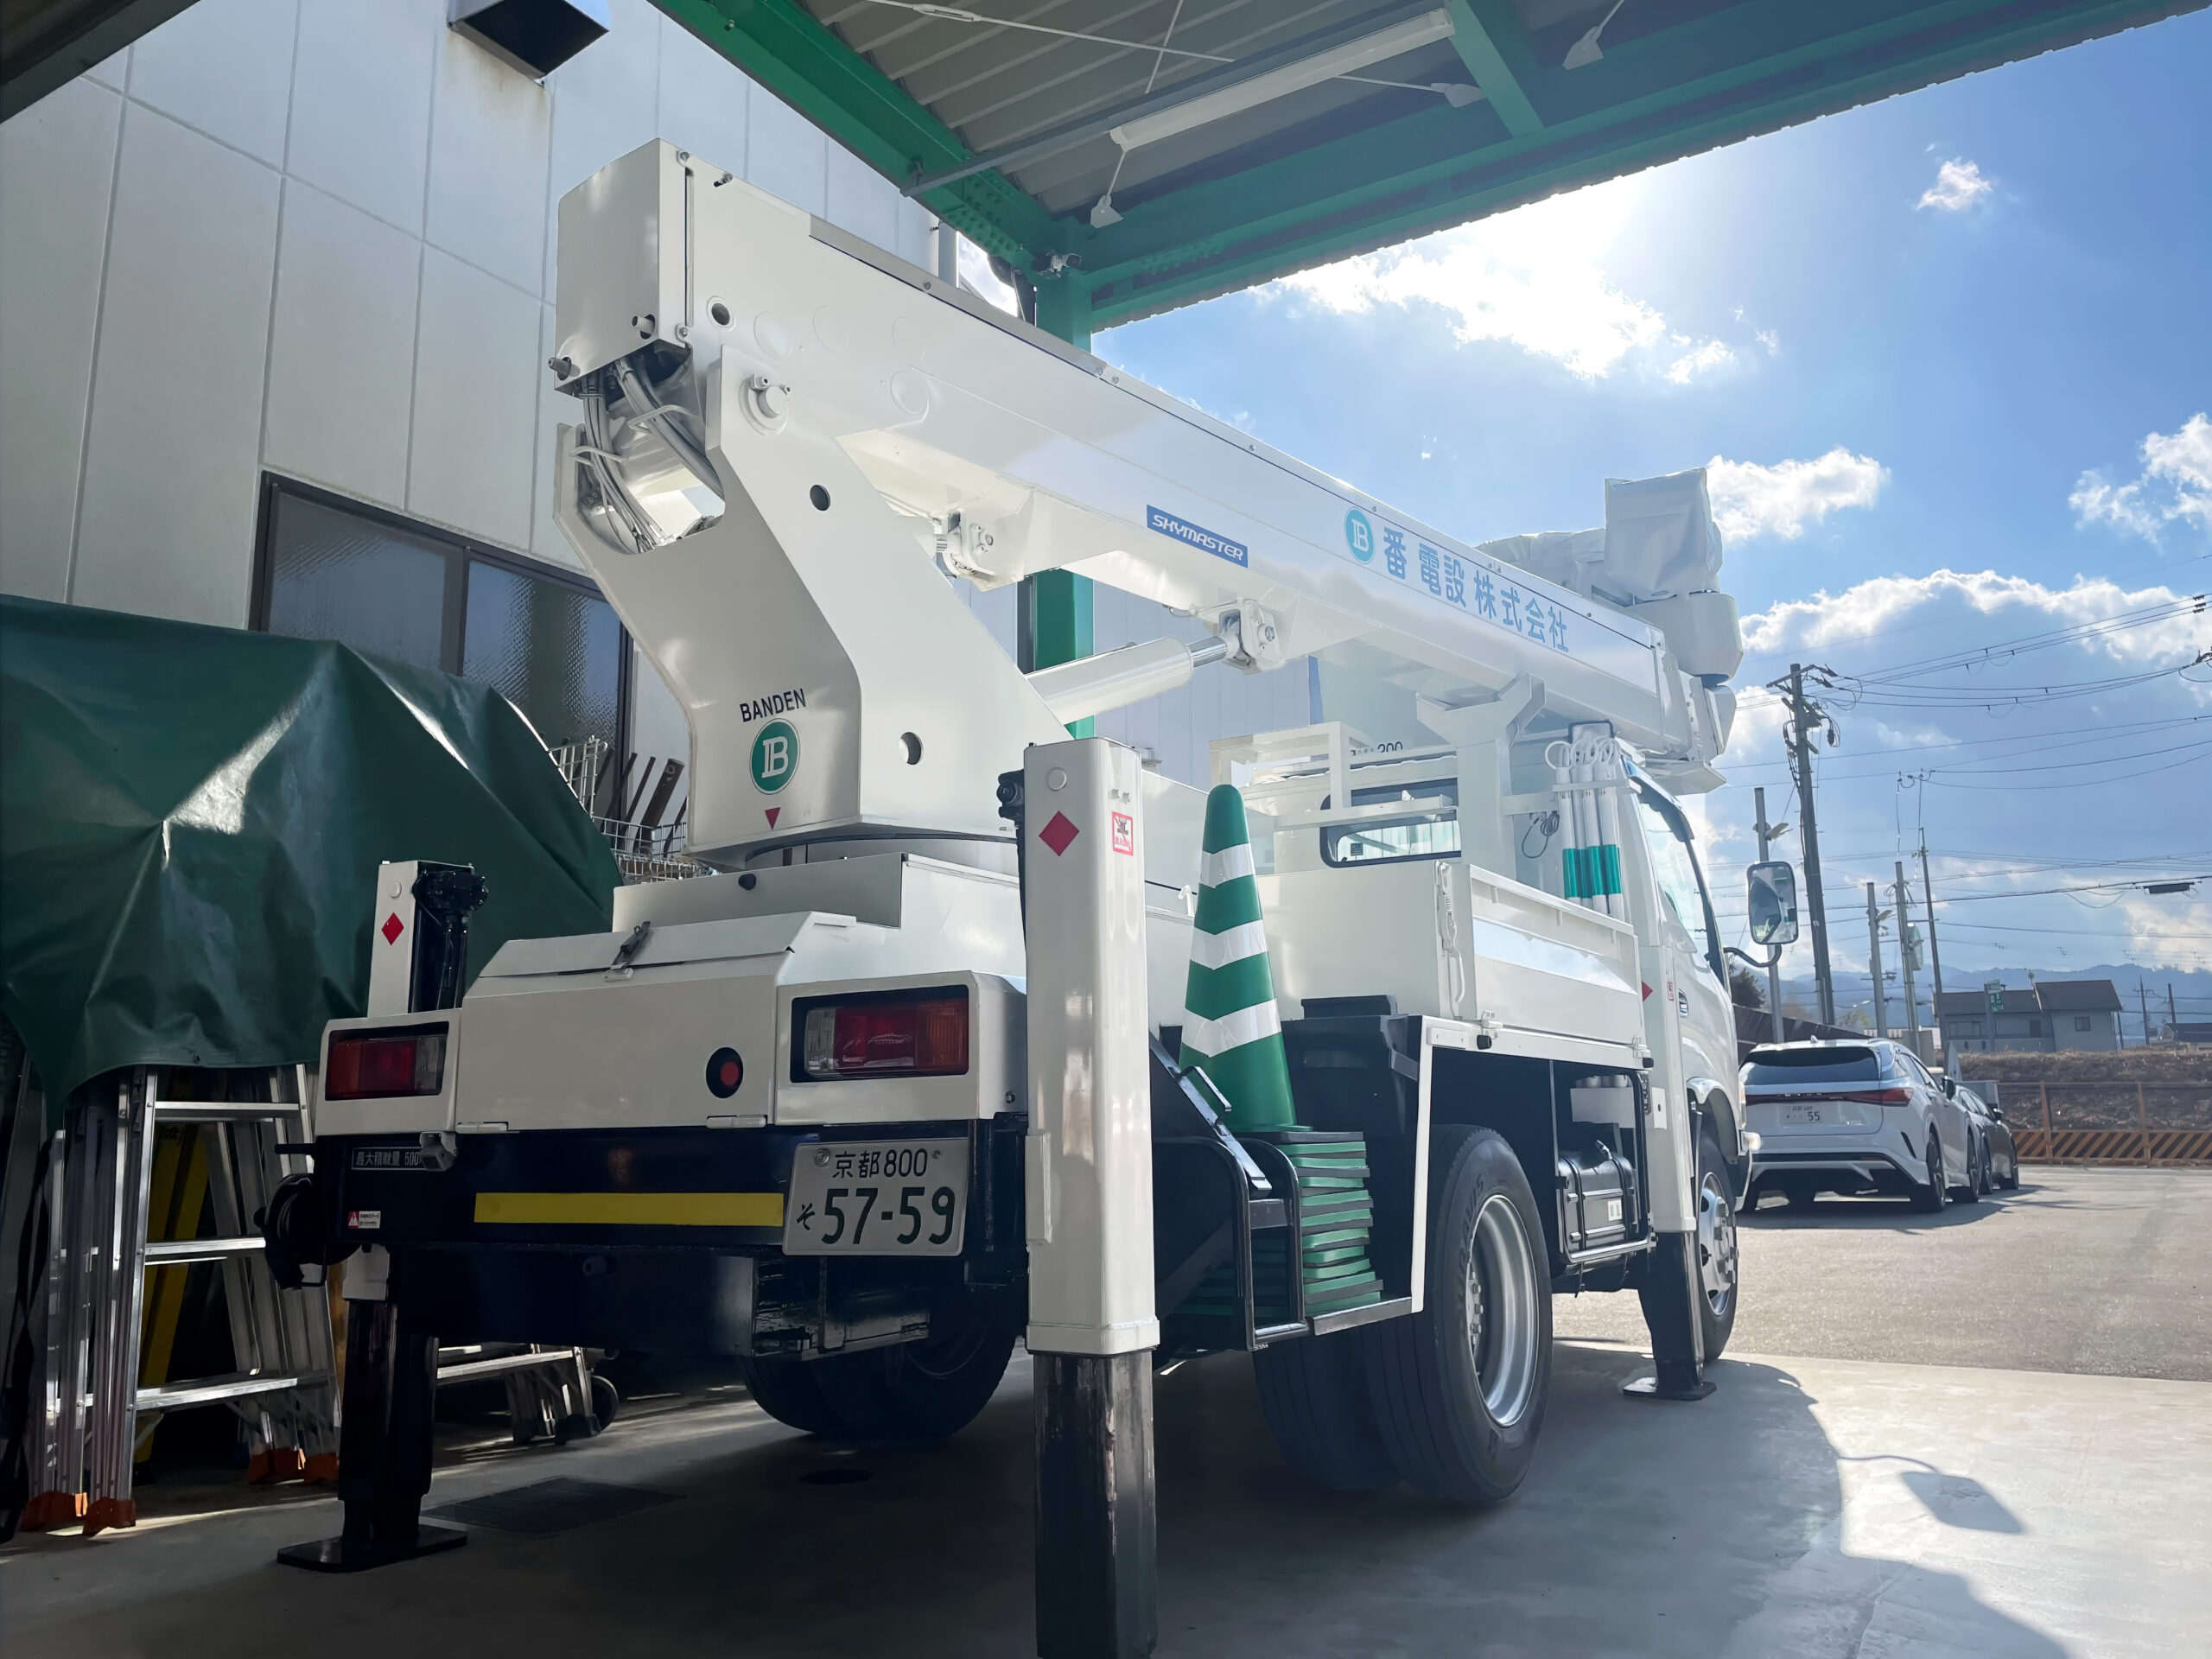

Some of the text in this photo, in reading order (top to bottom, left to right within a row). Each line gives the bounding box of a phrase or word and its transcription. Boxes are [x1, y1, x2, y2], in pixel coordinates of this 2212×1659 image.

[1152, 513, 1243, 561] SKYMASTER
[740, 688, 806, 722] BANDEN
[797, 1186, 956, 1244] そ 57-59
